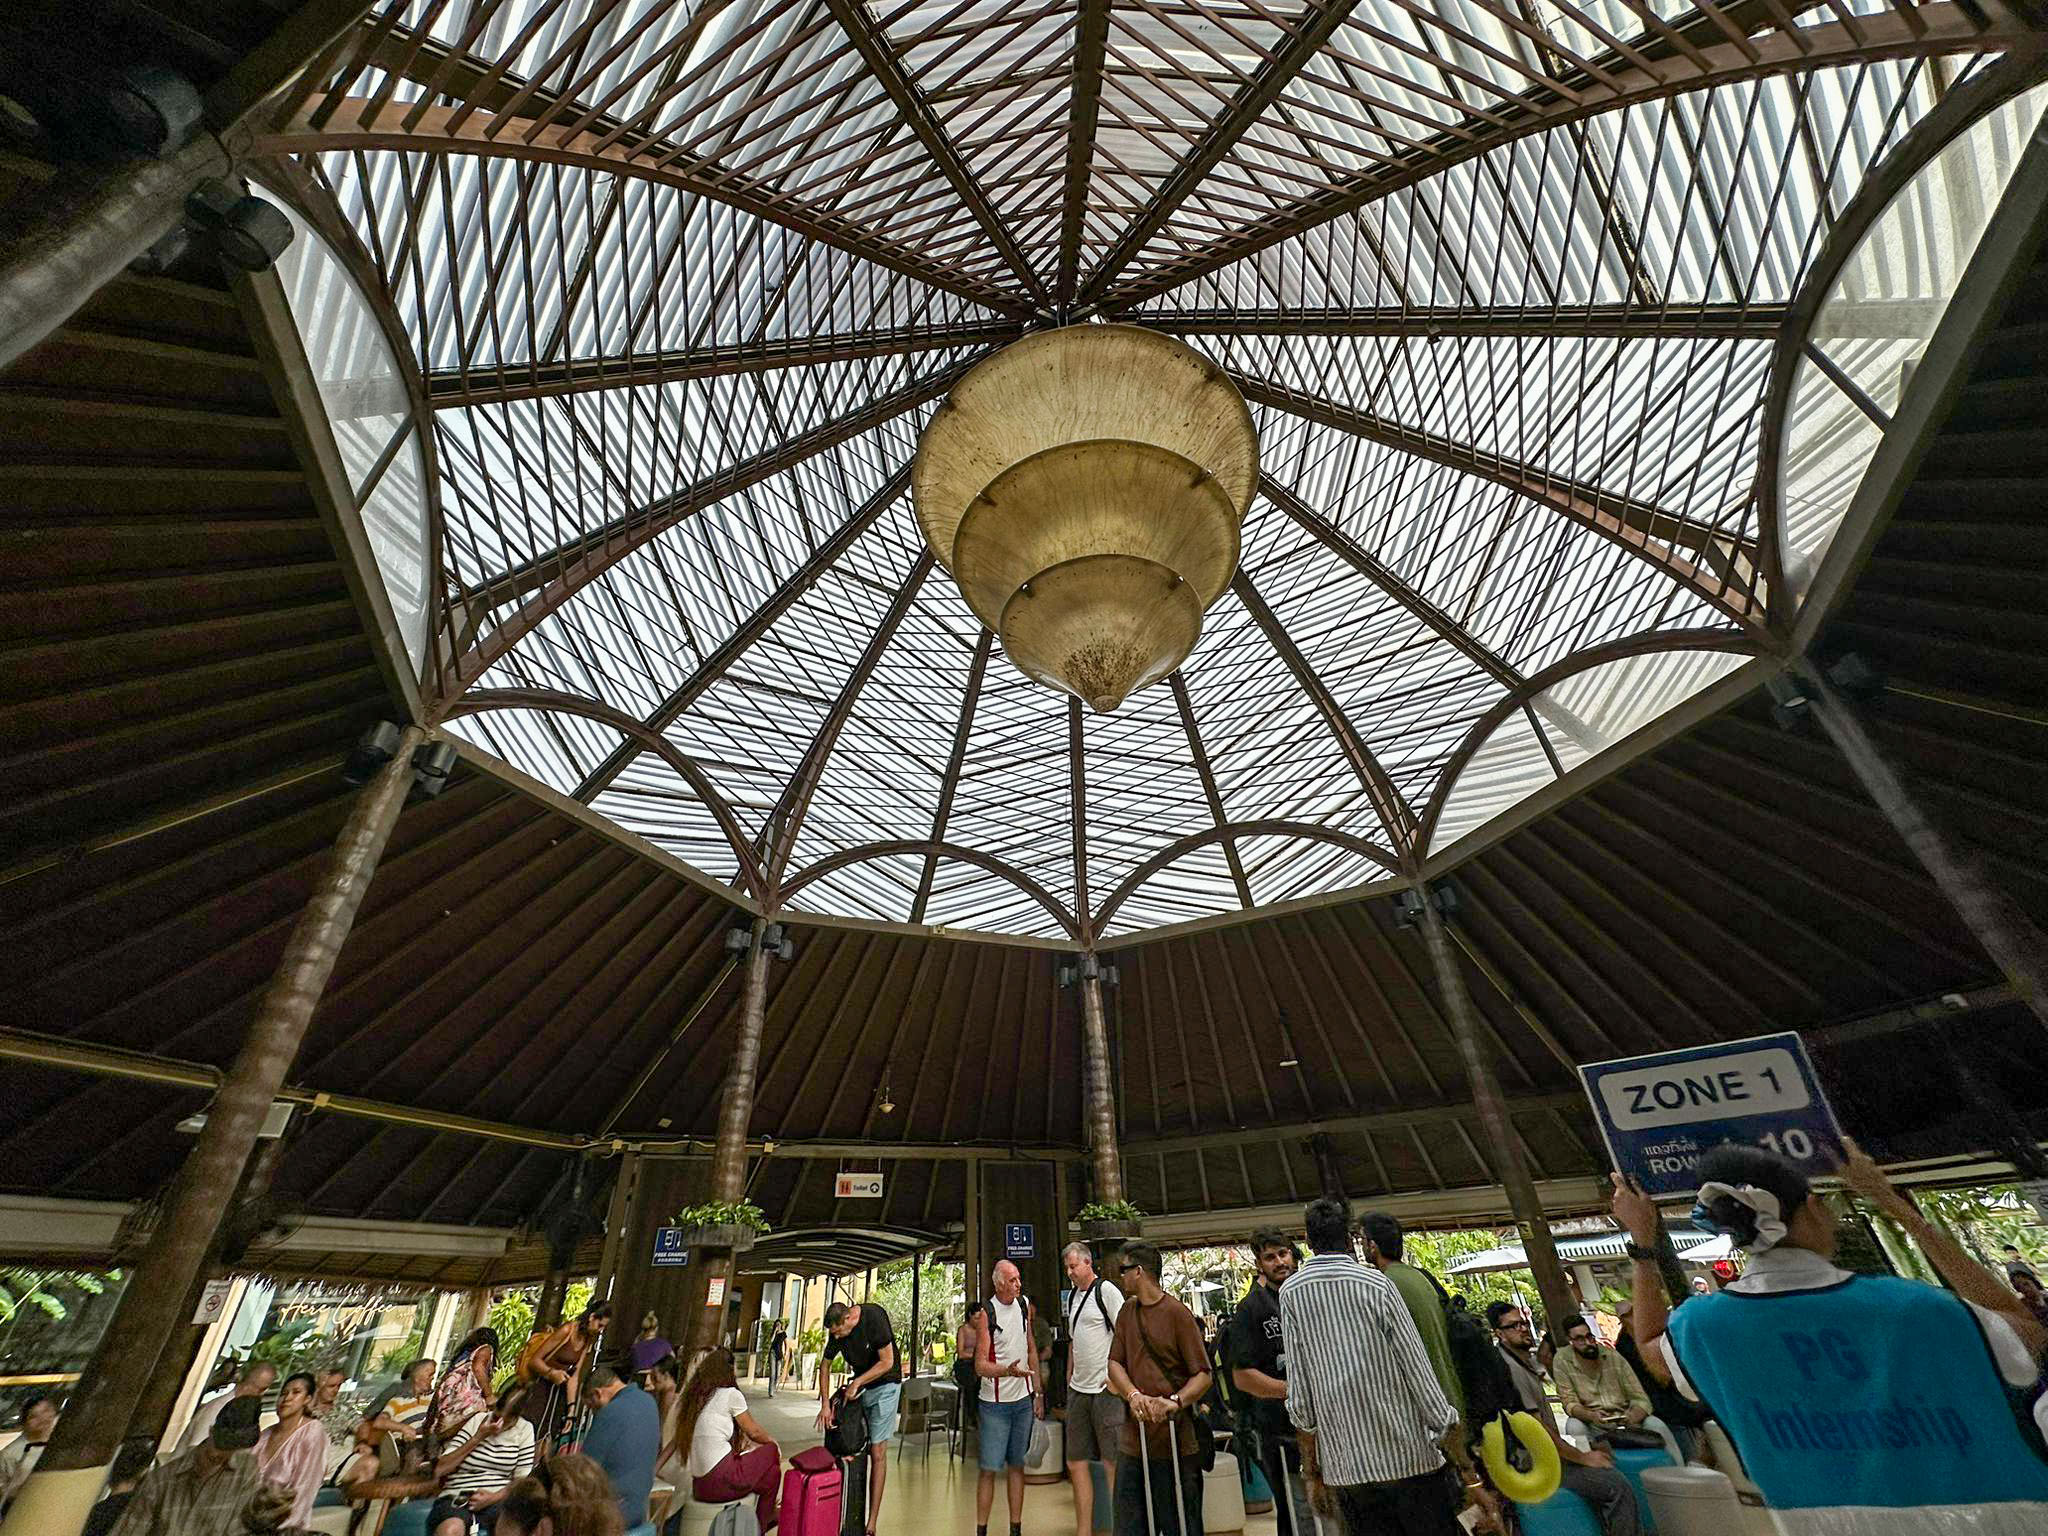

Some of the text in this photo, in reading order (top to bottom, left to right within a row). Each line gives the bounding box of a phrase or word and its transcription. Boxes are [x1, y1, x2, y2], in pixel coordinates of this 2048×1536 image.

[1623, 1067, 1782, 1114] ZONE 1
[280, 1292, 397, 1327] Here Coffee
[1780, 1327, 1869, 1382] PG
[1750, 1396, 1974, 1457] Internship
